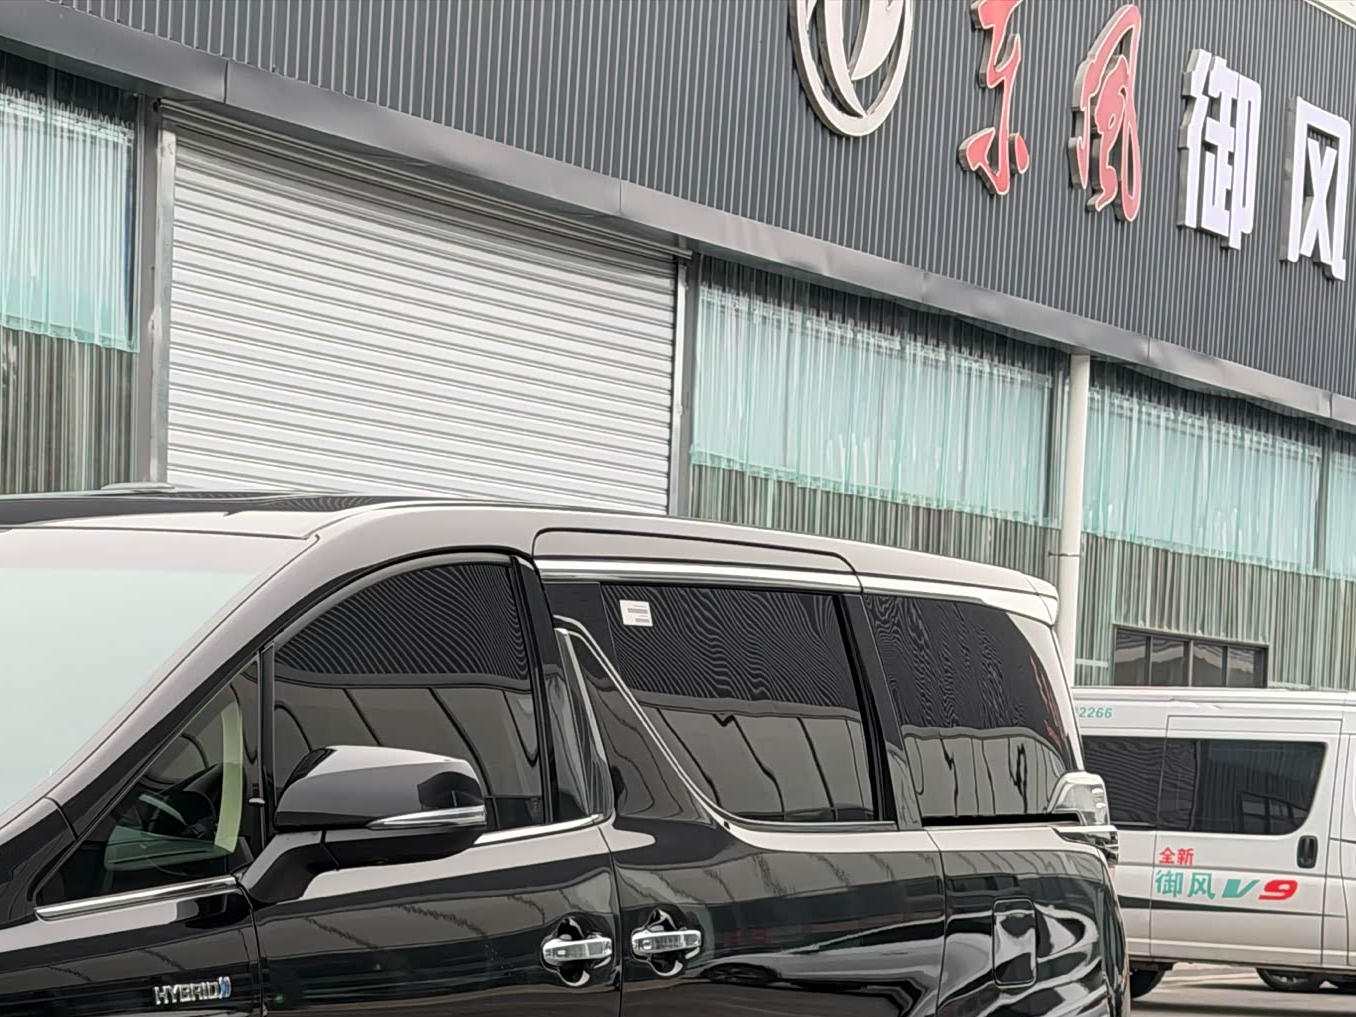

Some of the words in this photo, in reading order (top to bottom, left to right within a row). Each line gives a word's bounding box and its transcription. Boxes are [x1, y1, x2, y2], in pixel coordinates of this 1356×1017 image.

[1179, 48, 1352, 281] 御风
[1075, 706, 1113, 719] 2266
[1158, 847, 1194, 865] 全新
[153, 981, 220, 1005] HYBRID
